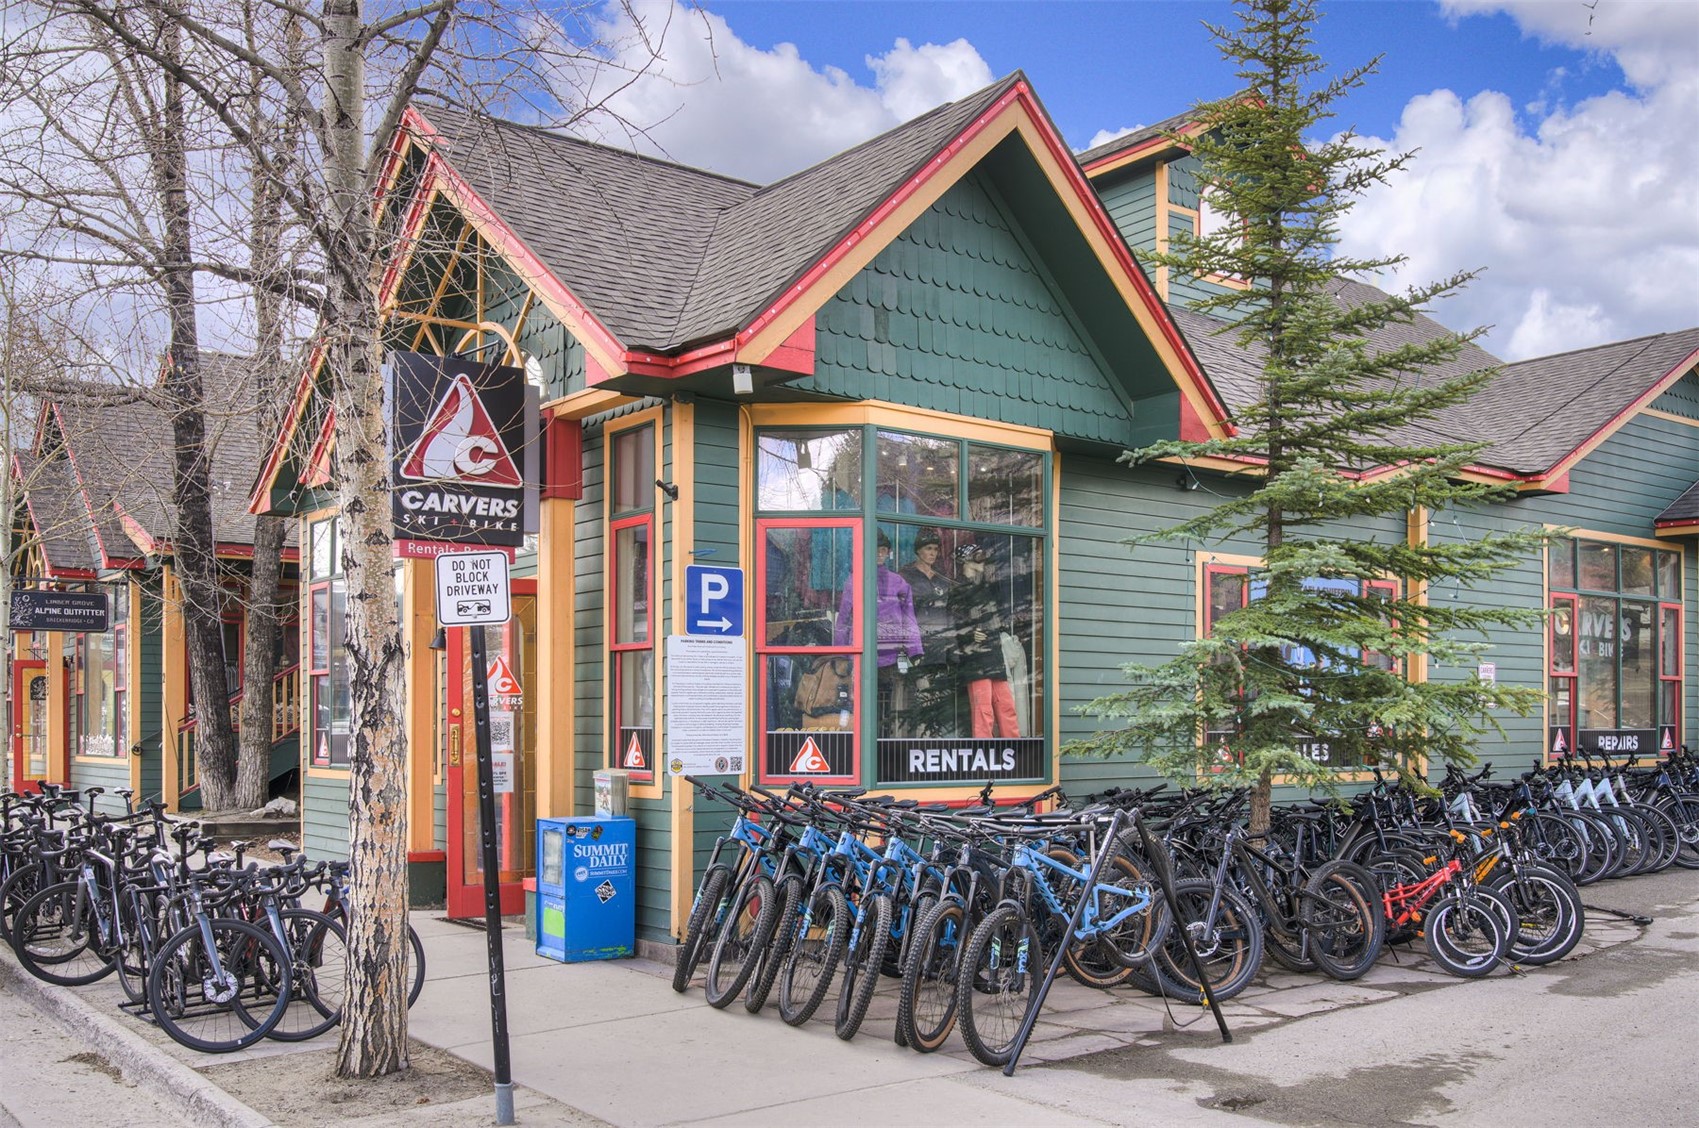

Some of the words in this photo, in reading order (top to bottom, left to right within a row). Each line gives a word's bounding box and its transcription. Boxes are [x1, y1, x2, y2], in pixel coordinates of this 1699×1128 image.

[401, 490, 519, 518] CARVERS
[402, 513, 438, 525] SKI
[469, 519, 518, 532] BIKE
[408, 542, 455, 554] Rentals
[452, 560, 465, 571] DO
[472, 559, 491, 570] NOT
[456, 571, 489, 583] BLOCK
[447, 583, 499, 596] DRIVEWAY
[701, 573, 729, 614] P
[34, 607, 62, 615] ALPINE
[63, 608, 105, 616] OUTFITTER
[1555, 610, 1632, 641] CRVES
[1598, 735, 1639, 751] REPAIRS
[909, 748, 1016, 773] RENTALS
[574, 843, 629, 858] SUMMIT
[590, 854, 627, 868] DAILY
